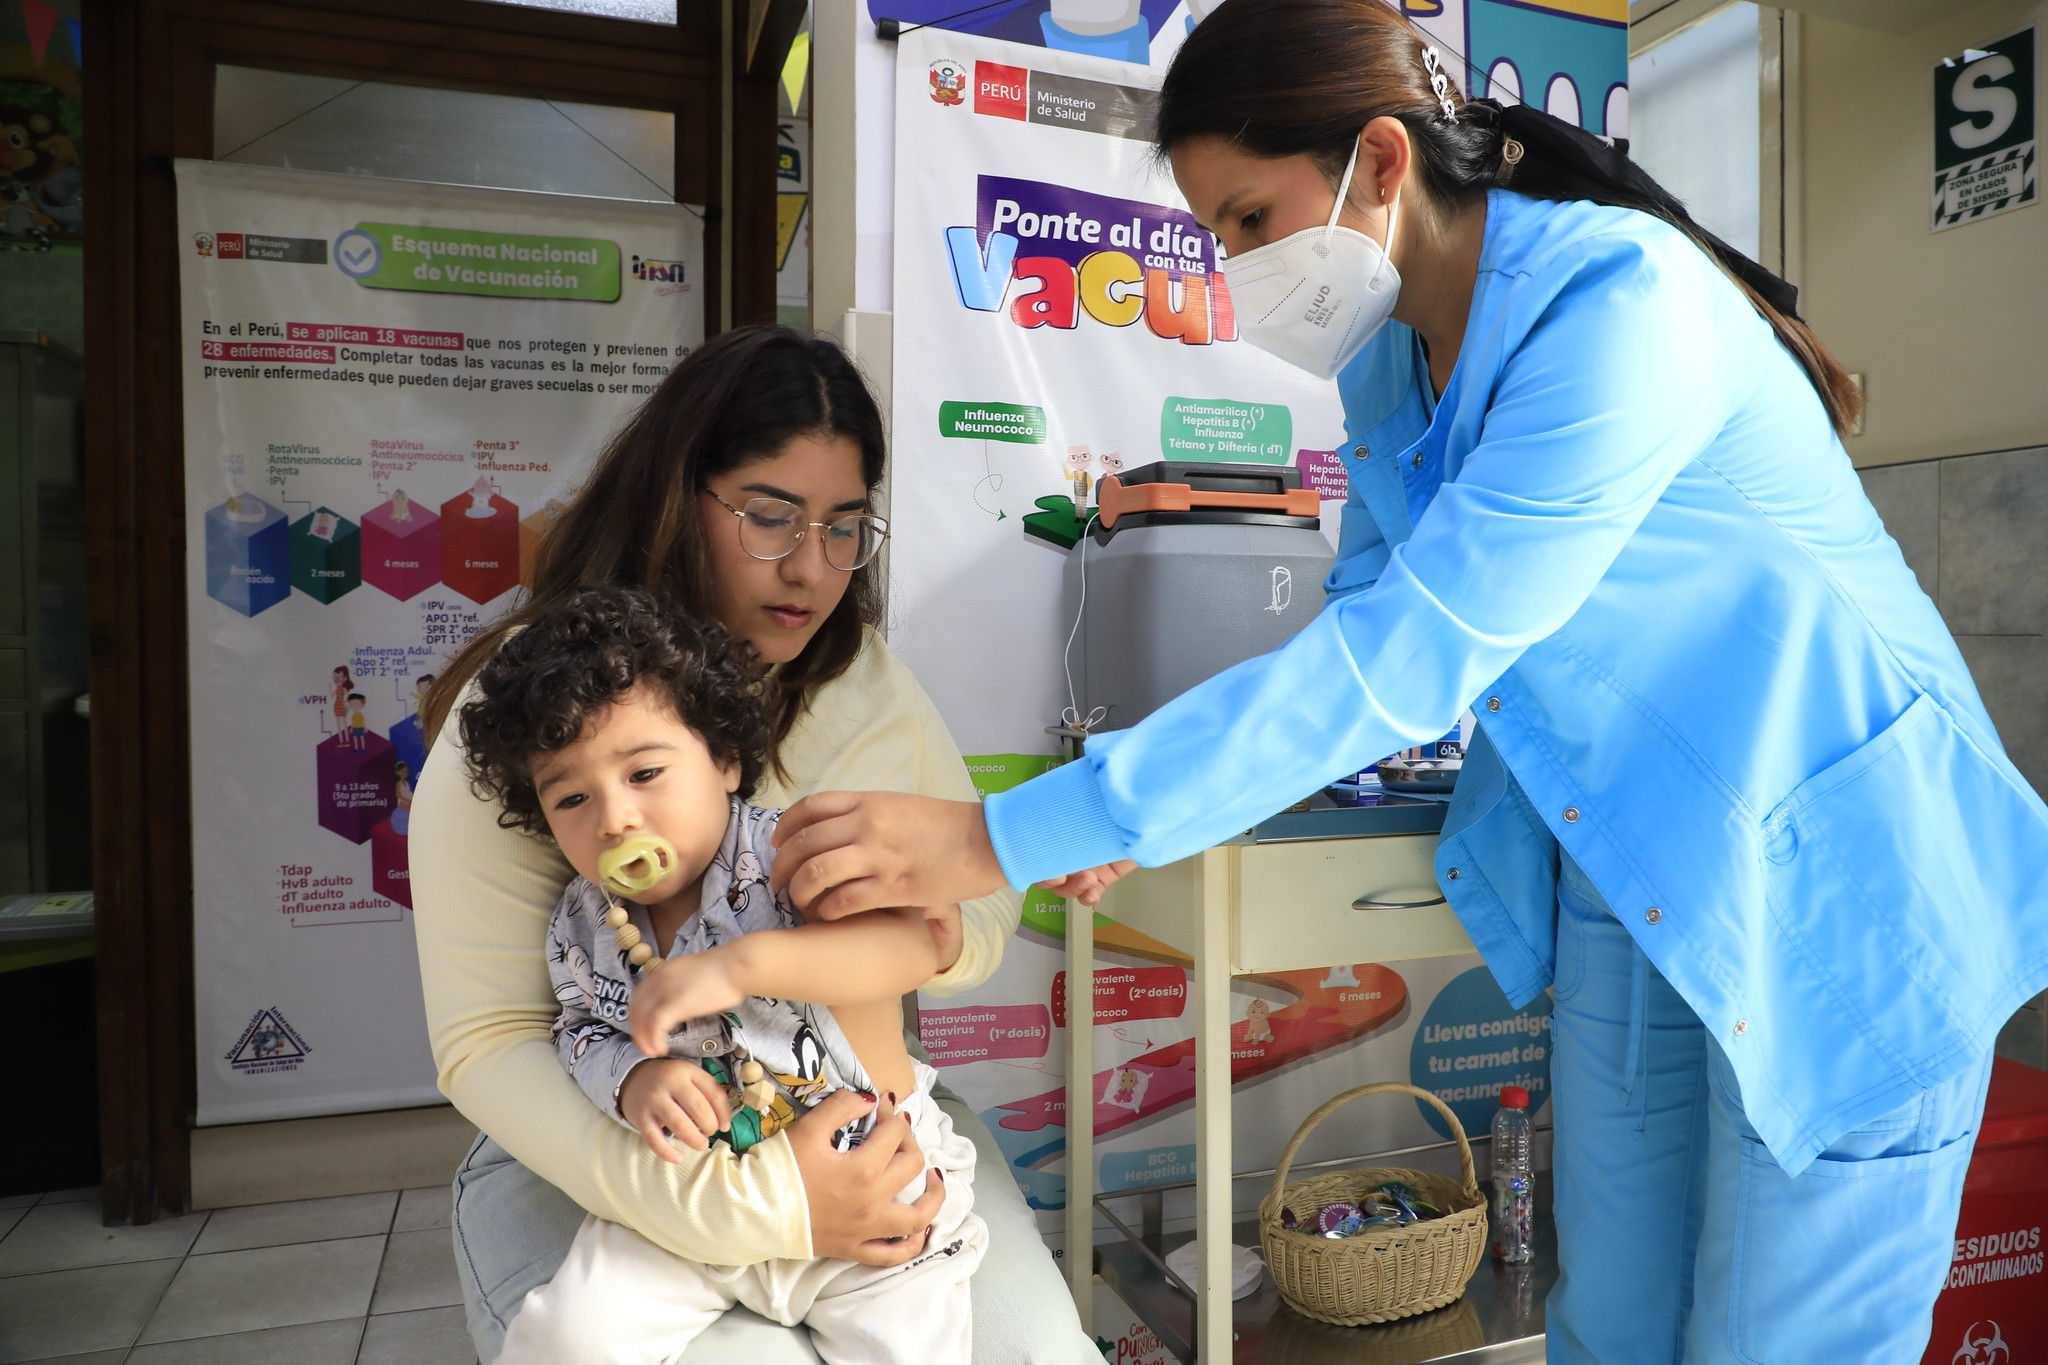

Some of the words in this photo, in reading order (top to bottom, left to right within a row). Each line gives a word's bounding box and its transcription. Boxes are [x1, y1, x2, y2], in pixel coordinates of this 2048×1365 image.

[980, 82, 1021, 101] PERÚ
[1037, 91, 1096, 110] Ministerio
[1949, 54, 2018, 150] S
[1037, 104, 1052, 116] de
[1054, 107, 1087, 122] Salud
[1949, 176, 1975, 191] ZONA
[1977, 162, 2018, 182] SEGURA
[1959, 187, 1972, 198] EN
[1974, 177, 2008, 194] CASOS
[1957, 199, 1970, 210] DE
[1972, 187, 2009, 206] SISMOS
[993, 198, 1102, 245] Ponte
[1109, 217, 1142, 250] al
[1149, 223, 1202, 259] día
[218, 239, 242, 252] PERÚ
[249, 237, 290, 250] Ministerio
[391, 234, 497, 261] Esquema
[500, 243, 598, 266] Nacional
[249, 249, 260, 258] de
[260, 249, 284, 259] Salud
[1144, 254, 1176, 271] con
[1178, 256, 1206, 274] tus
[413, 264, 441, 281] de
[445, 265, 579, 289] Vacunación
[1303, 285, 1331, 323] ELIUD
[202, 320, 221, 335] En
[229, 322, 242, 336] el
[248, 321, 285, 340] Perú,
[291, 326, 309, 339] se
[316, 326, 369, 345] aplican
[376, 330, 396, 344] 18
[402, 333, 459, 348] vacunas
[466, 337, 491, 351] que
[498, 339, 522, 351] nos
[528, 340, 587, 355] protegen
[592, 342, 601, 356] y
[606, 342, 668, 358] previenen
[675, 344, 690, 357] de
[203, 342, 223, 357] 28
[230, 344, 334, 361] enfermedades.
[340, 347, 414, 366] Completar
[420, 353, 458, 368] todas
[464, 355, 485, 369] las
[490, 358, 545, 371] vacunas
[550, 359, 566, 372] es
[572, 359, 584, 372] la
[590, 361, 626, 377] mejor
[632, 361, 669, 376] forma
[203, 364, 261, 379] prevenir
[264, 366, 365, 383] enfermedades
[367, 371, 394, 385] que
[398, 374, 449, 388] pueden
[452, 375, 488, 391] dejar
[490, 378, 534, 393] graves
[536, 379, 594, 393] secuelas
[597, 383, 606, 394] o
[608, 384, 628, 394] ser
[964, 409, 1025, 424] Influenza
[1174, 403, 1248, 418] Antiamarílica
[954, 420, 1034, 436] Neumococo
[1182, 415, 1231, 428] Hepatitis
[1232, 418, 1239, 428] B
[1194, 427, 1244, 440] Influenza
[268, 444, 321, 455] RotaVirus
[371, 439, 425, 451] RotaVirus
[476, 440, 506, 451] Penta
[1168, 438, 1206, 451] Tétano
[1207, 442, 1215, 453] y
[1217, 441, 1257, 454] Difteria
[268, 455, 363, 467] Antineumocócica
[370, 449, 464, 463] Antineumocócica
[477, 451, 495, 461] IPV
[269, 466, 300, 476] Penta
[371, 460, 403, 472] Penta
[477, 461, 526, 472] Influenza
[528, 462, 552, 473] Ped.
[269, 476, 287, 487] IPV
[372, 470, 391, 481] IPV
[383, 559, 391, 568] 4
[391, 560, 420, 569] meses
[464, 559, 471, 568] 6
[472, 560, 499, 569] meses
[310, 568, 317, 578] 2
[317, 569, 346, 578] meses
[427, 601, 446, 611] IPV
[425, 613, 449, 624] APO
[426, 625, 446, 635] SPR
[425, 635, 448, 645] DPT
[354, 646, 405, 656] Influenza
[355, 656, 377, 668] Apo
[355, 667, 377, 678] DPT
[303, 695, 328, 706] VPH
[334, 782, 341, 792] 9
[349, 782, 359, 791] 13
[359, 782, 380, 791] años
[336, 799, 348, 808] de
[348, 797, 388, 809] primaria)
[351, 790, 376, 802] grado
[280, 864, 313, 878] Tdap
[281, 878, 309, 889] HvB
[311, 875, 354, 888] adulto
[281, 891, 298, 903] dT
[302, 889, 344, 902] adulto
[282, 902, 346, 915] Influenza
[348, 898, 391, 911] adulto
[1147, 983, 1184, 998] dosis)
[1339, 992, 1346, 1002] 6
[1347, 991, 1382, 1002] meses
[920, 1012, 997, 1026] Pentavalente
[920, 1025, 975, 1039] Rotavirus
[1007, 1024, 1047, 1040] dosis)
[1423, 1023, 1478, 1044] Lleva
[920, 1038, 948, 1049] Polio
[928, 1046, 988, 1060] eumococo
[1230, 1048, 1265, 1060] meses
[1428, 1055, 1452, 1074] tu
[1453, 1046, 1520, 1072] carnet
[1521, 1043, 1546, 1062] de
[1148, 1151, 1178, 1166] BCG
[1124, 1163, 1188, 1183] Hepatitis
[1952, 1226, 2042, 1263] ESIDUOS
[1129, 1322, 1147, 1337] Con
